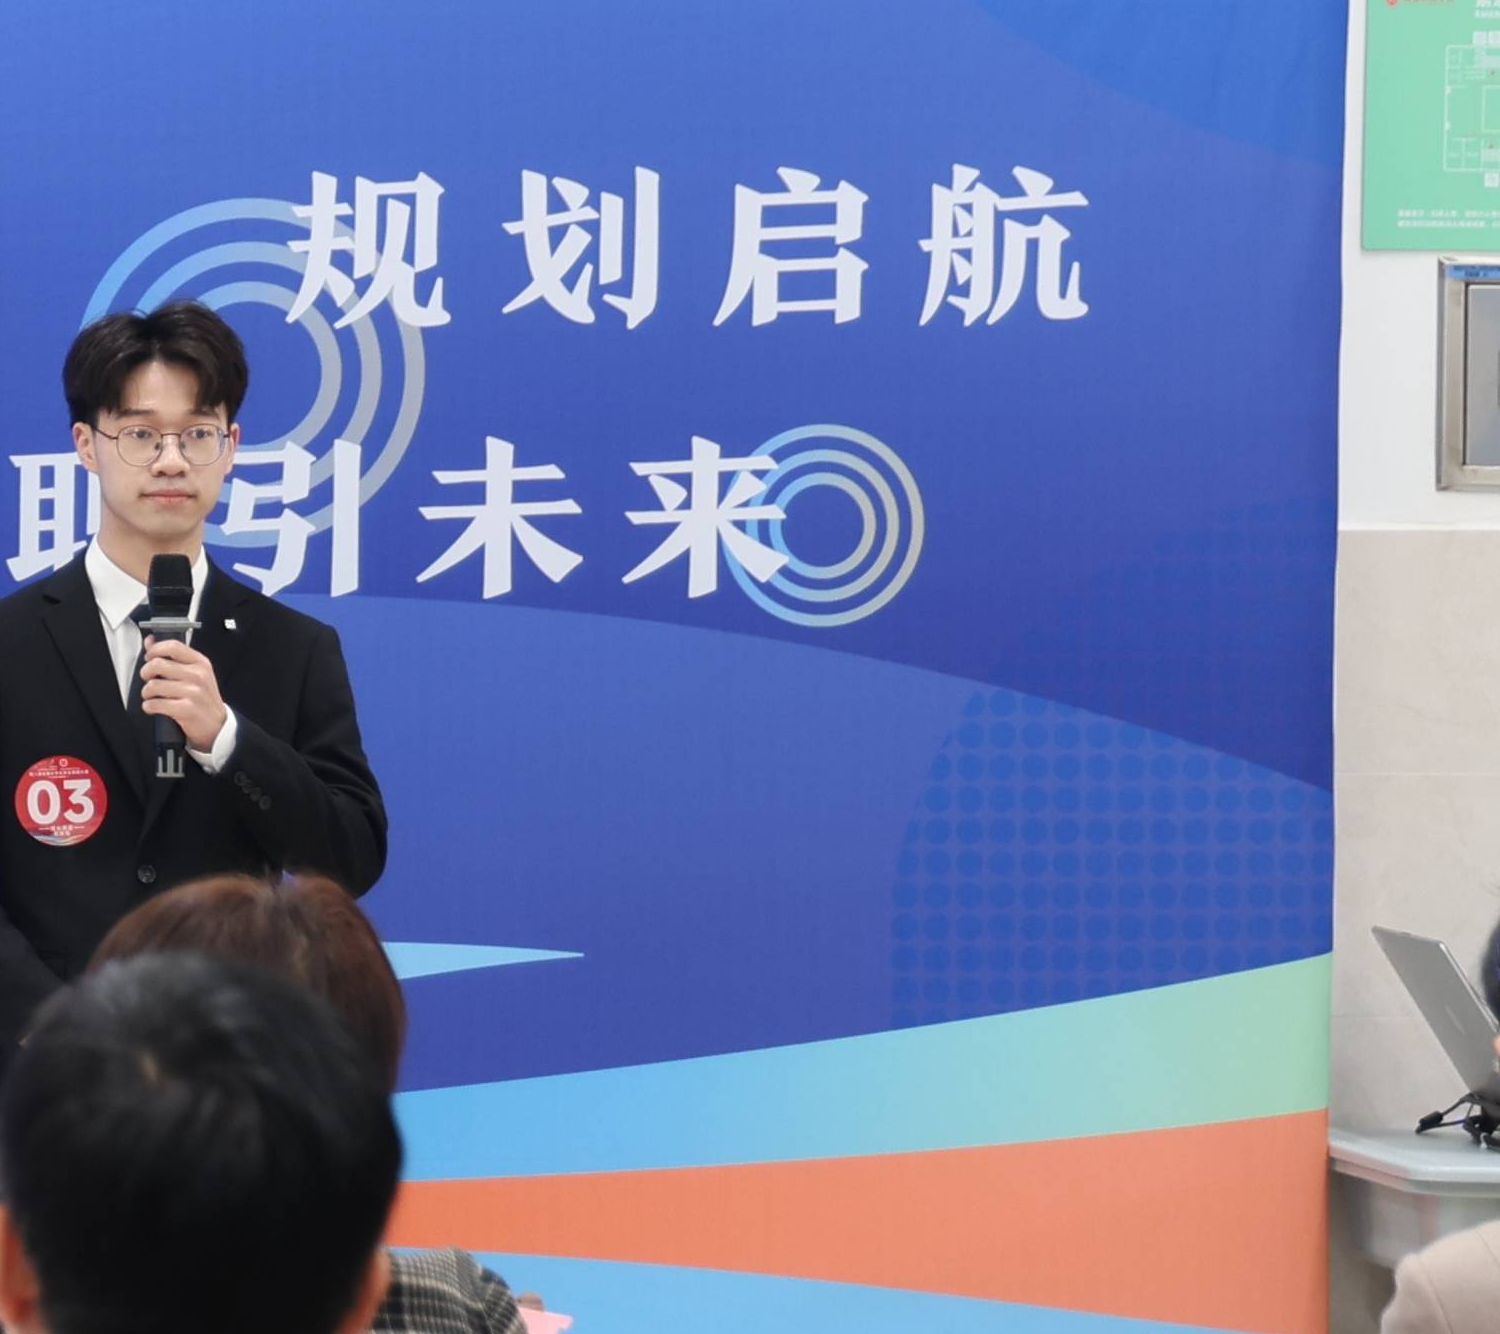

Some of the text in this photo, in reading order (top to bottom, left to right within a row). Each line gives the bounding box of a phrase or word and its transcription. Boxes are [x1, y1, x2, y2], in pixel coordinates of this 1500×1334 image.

[285, 162, 1091, 329] 规划启航
[27, 778, 95, 825] 03
